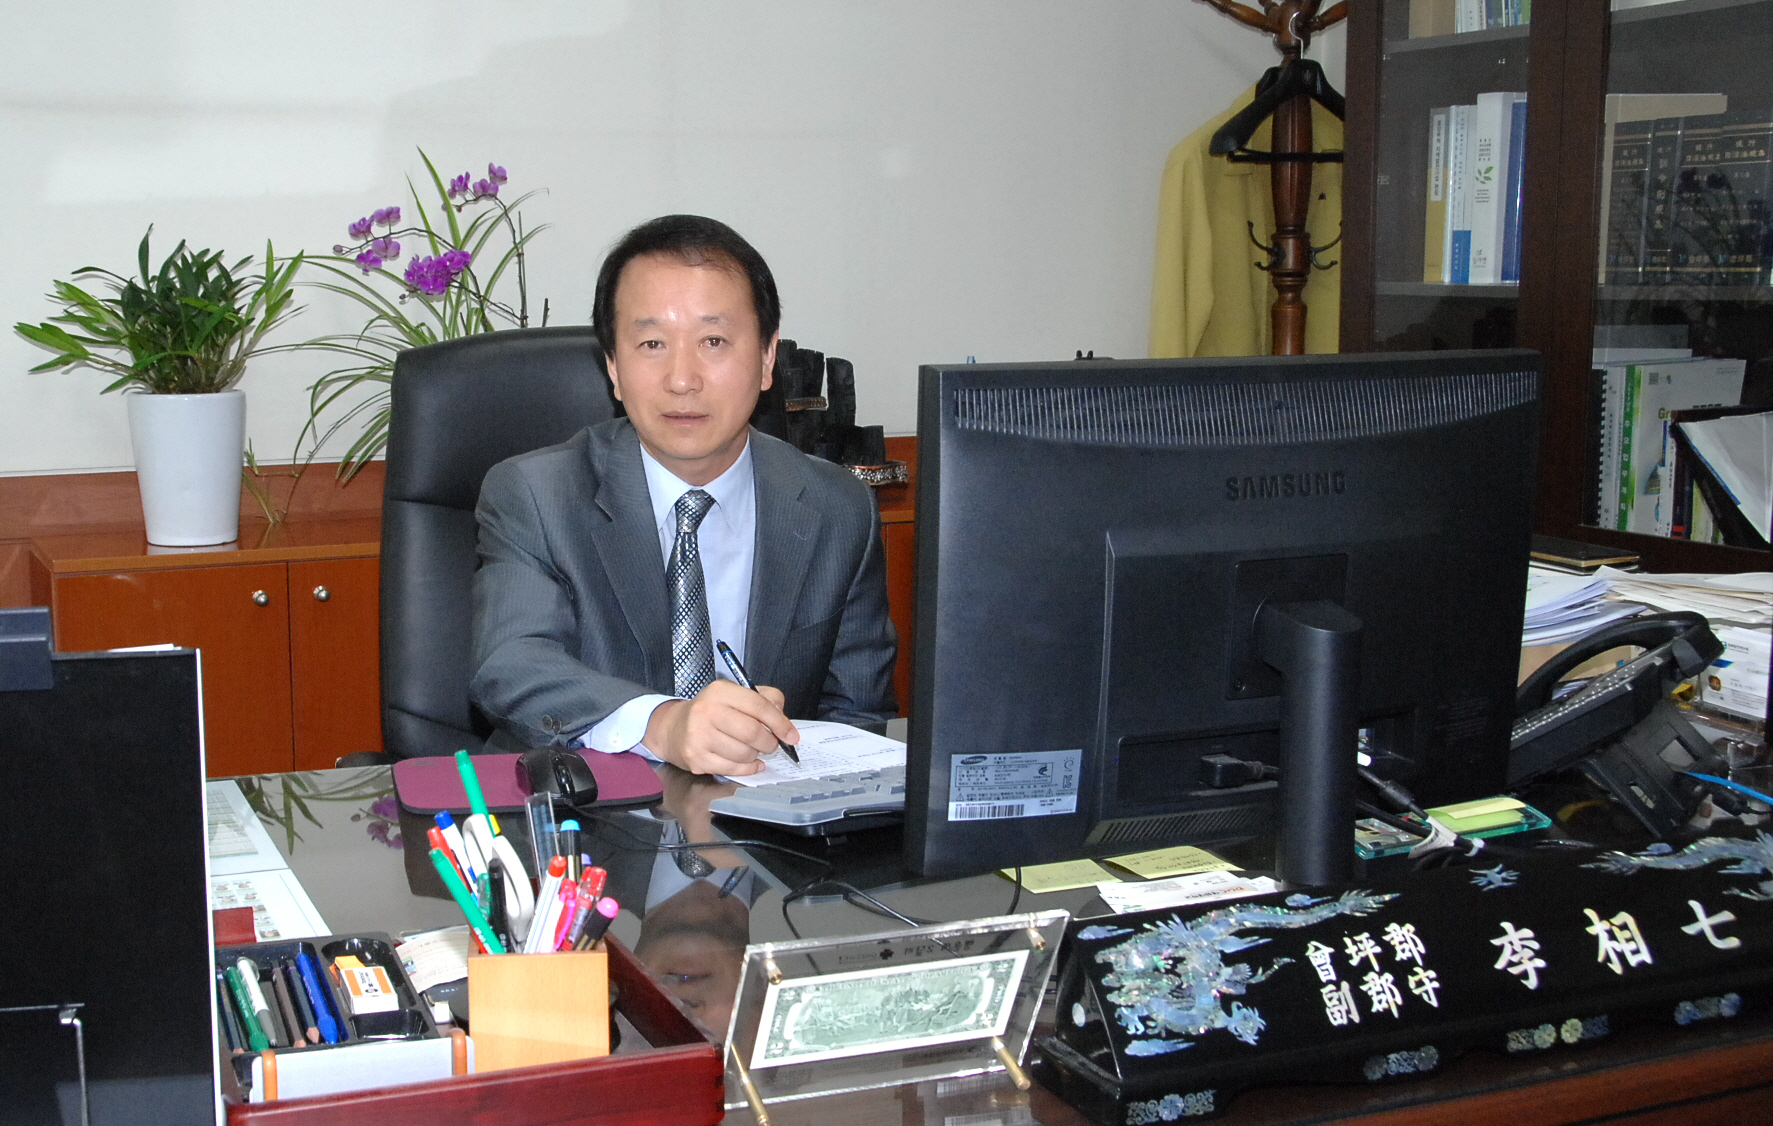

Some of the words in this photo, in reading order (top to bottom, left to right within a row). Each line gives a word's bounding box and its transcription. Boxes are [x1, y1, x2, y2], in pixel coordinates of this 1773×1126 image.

[1226, 471, 1347, 501] SAMSUNG
[1320, 967, 1440, 1027] 副郡守
